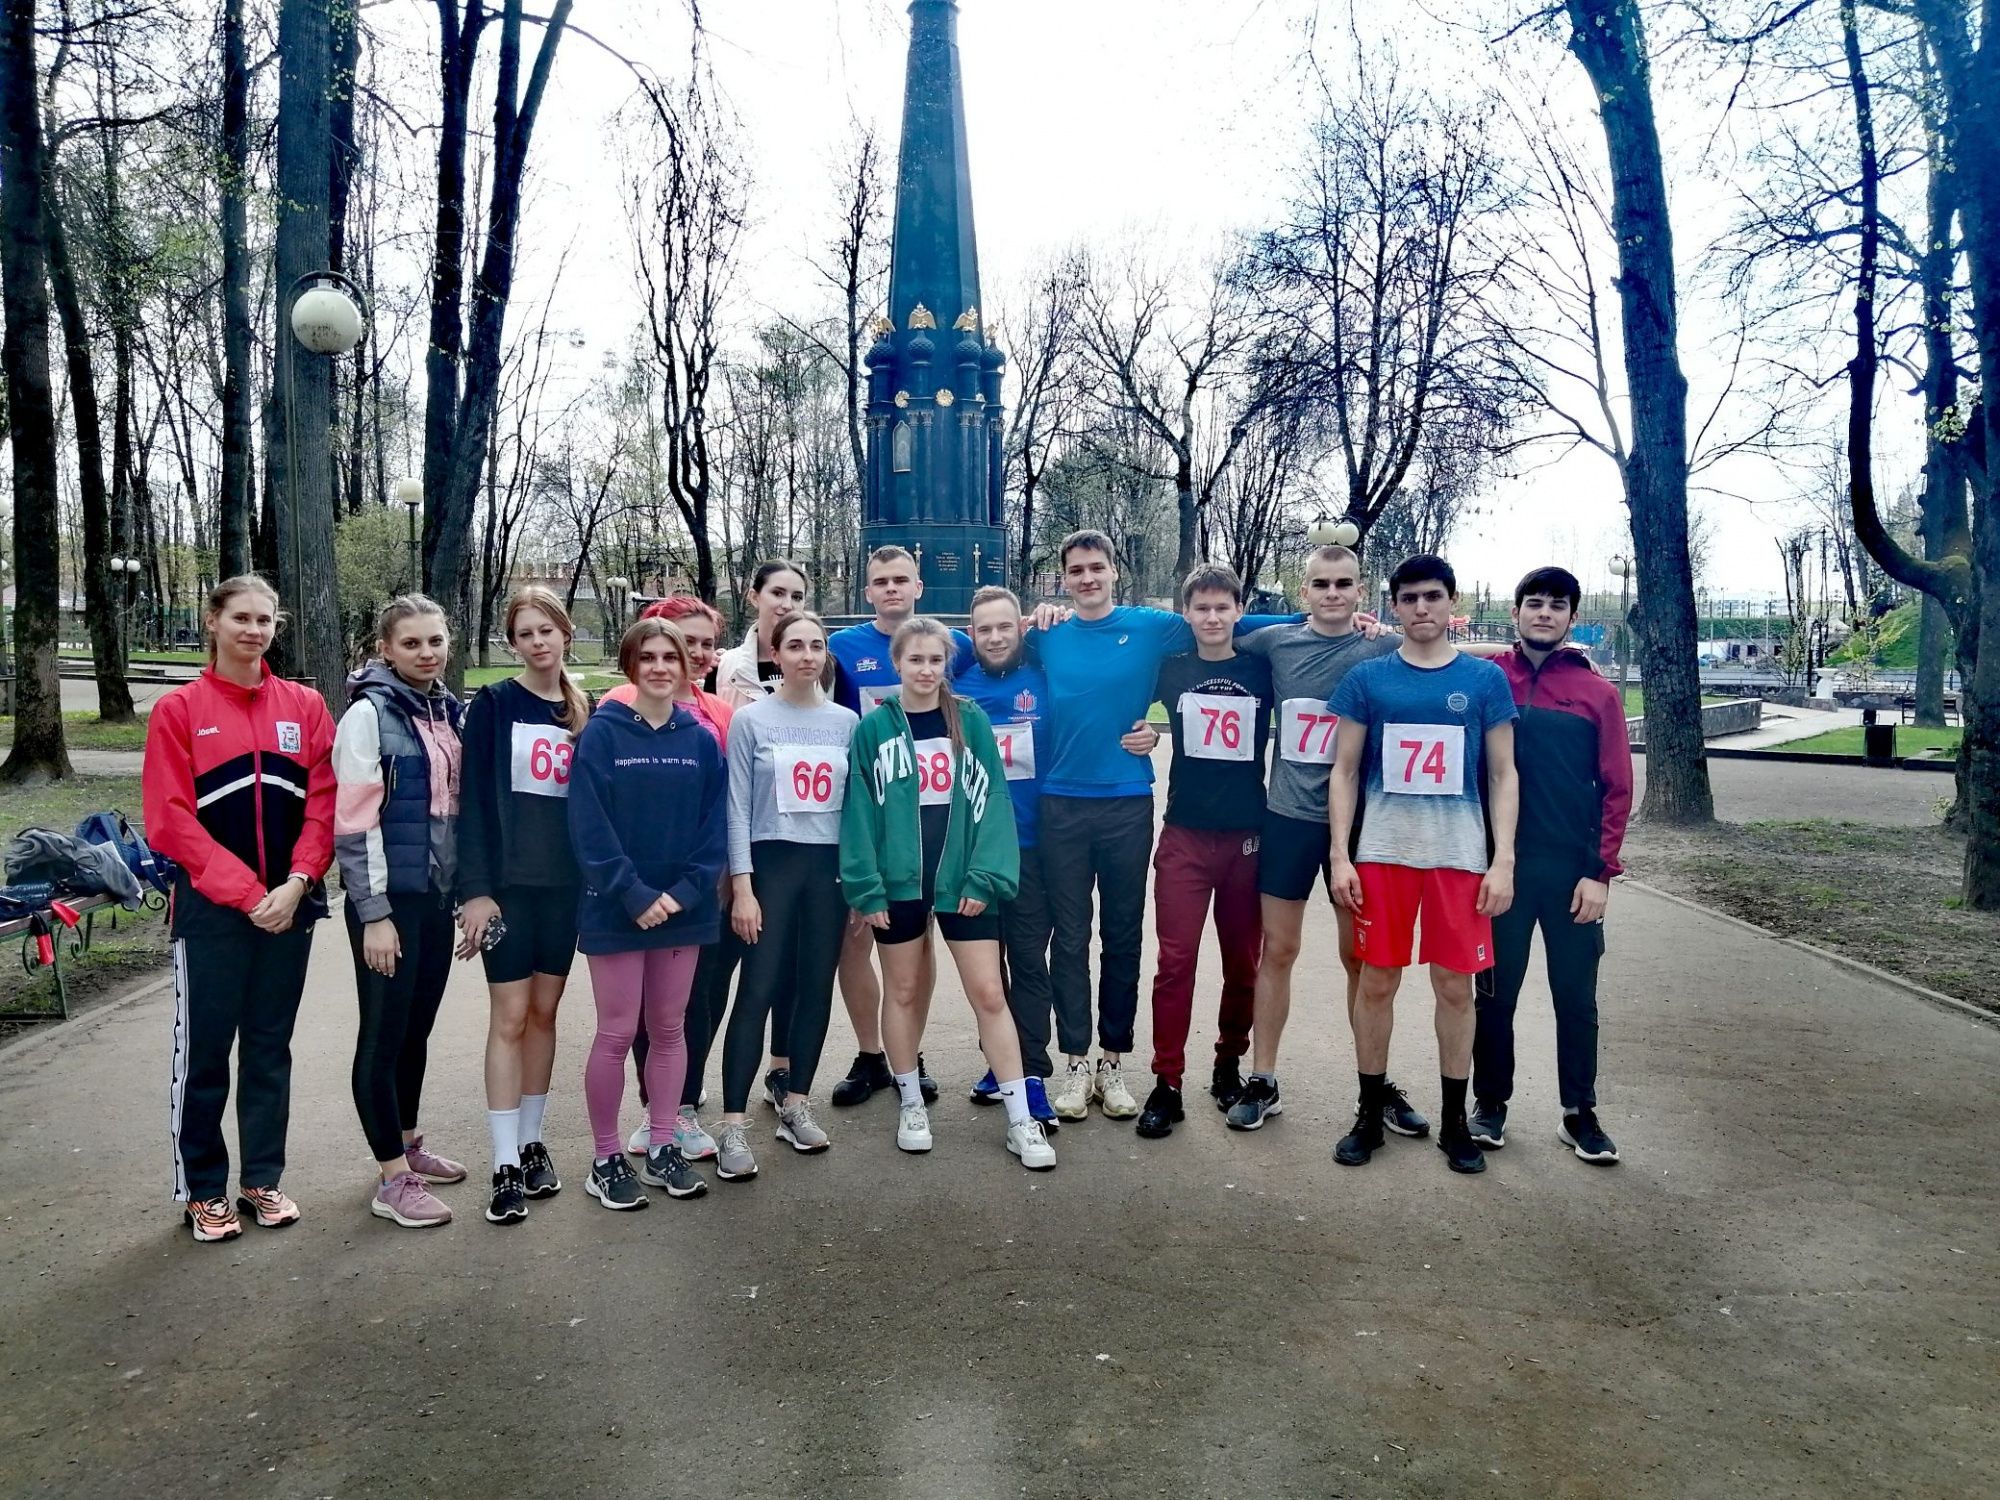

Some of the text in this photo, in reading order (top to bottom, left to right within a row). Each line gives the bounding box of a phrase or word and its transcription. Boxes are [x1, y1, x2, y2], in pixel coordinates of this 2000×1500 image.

[767, 726, 846, 747] CONVERSE
[1200, 707, 1240, 749] 76
[1297, 713, 1338, 755] 77
[531, 738, 574, 785] 63
[615, 757, 650, 768] Happiness
[652, 756, 659, 765] is
[793, 760, 833, 803] 66
[874, 731, 912, 807] OWN
[1400, 740, 1446, 784] 74
